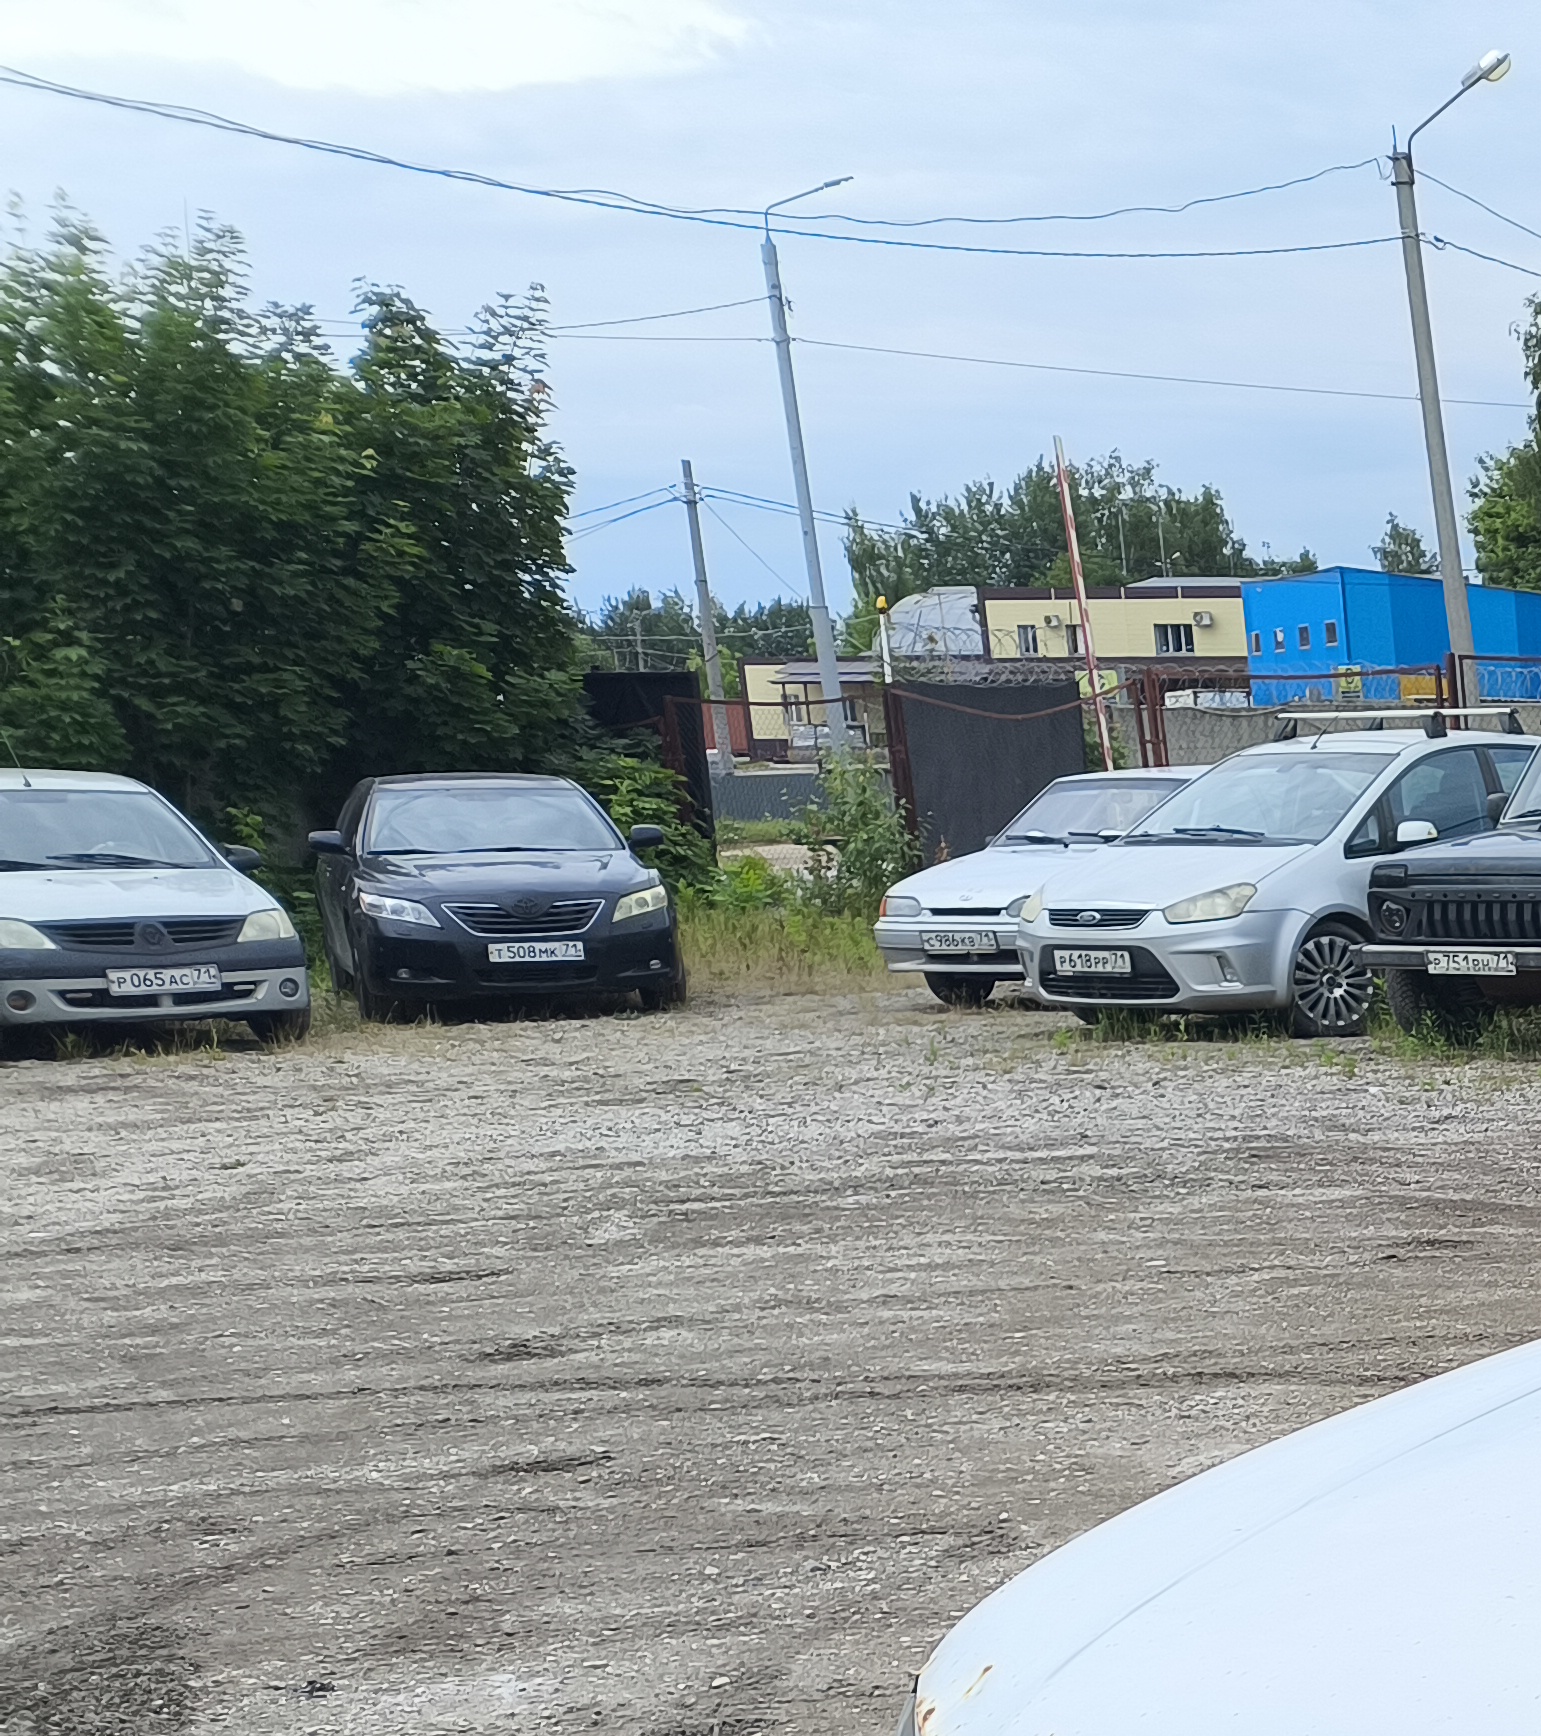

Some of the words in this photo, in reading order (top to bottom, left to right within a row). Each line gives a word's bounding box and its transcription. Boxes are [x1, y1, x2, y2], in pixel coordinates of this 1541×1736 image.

[495, 945, 558, 959] Т508МК
[562, 943, 579, 954] 71
[1059, 953, 1108, 969] Р618РР
[1110, 952, 1126, 967] 71
[1493, 953, 1510, 969] 71
[116, 971, 190, 989] Р065АС
[193, 967, 212, 981] 71
